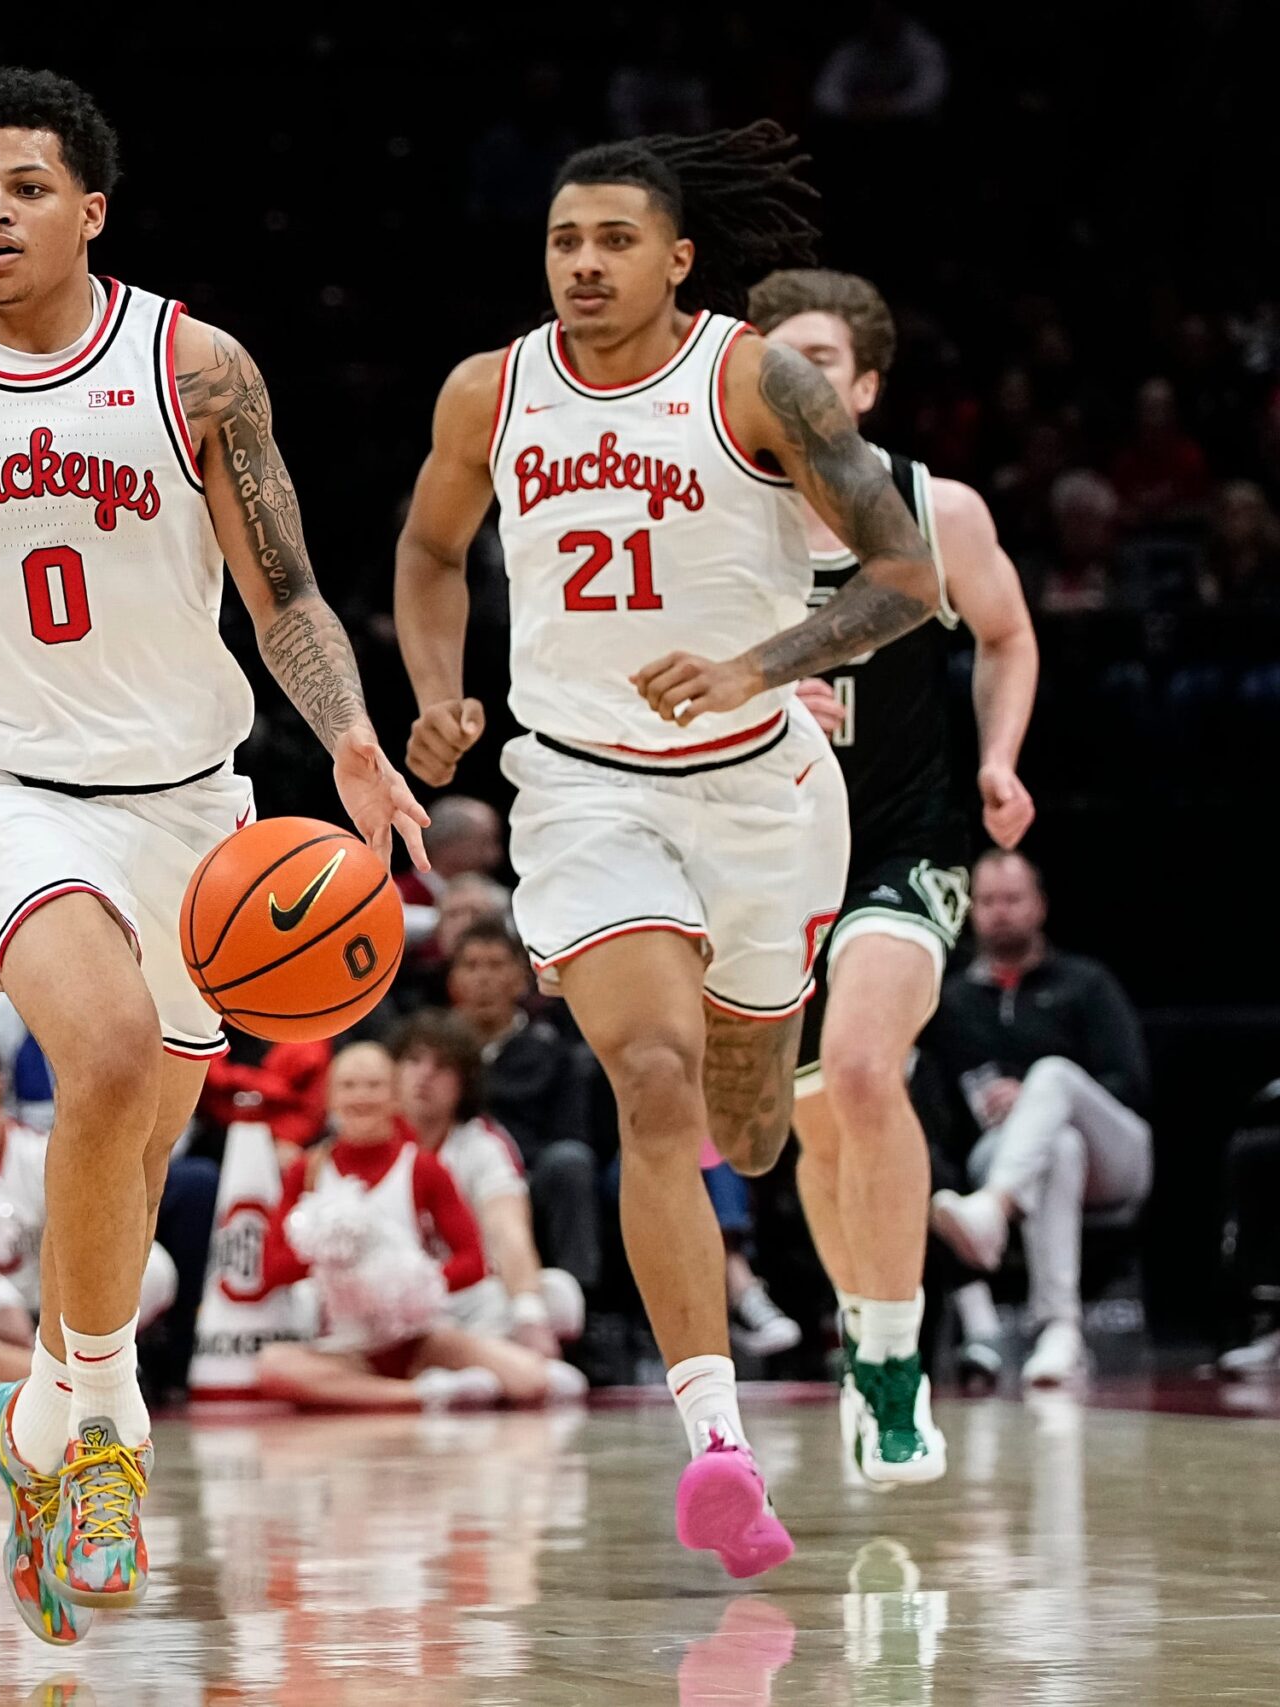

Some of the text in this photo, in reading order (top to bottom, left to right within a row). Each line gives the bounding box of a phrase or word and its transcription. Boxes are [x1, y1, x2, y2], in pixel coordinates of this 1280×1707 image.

[89, 390, 135, 408] B1G
[221, 415, 291, 601] Fearless
[514, 432, 705, 520] Buckeyes
[22, 545, 92, 645] 0
[558, 529, 663, 611] 21
